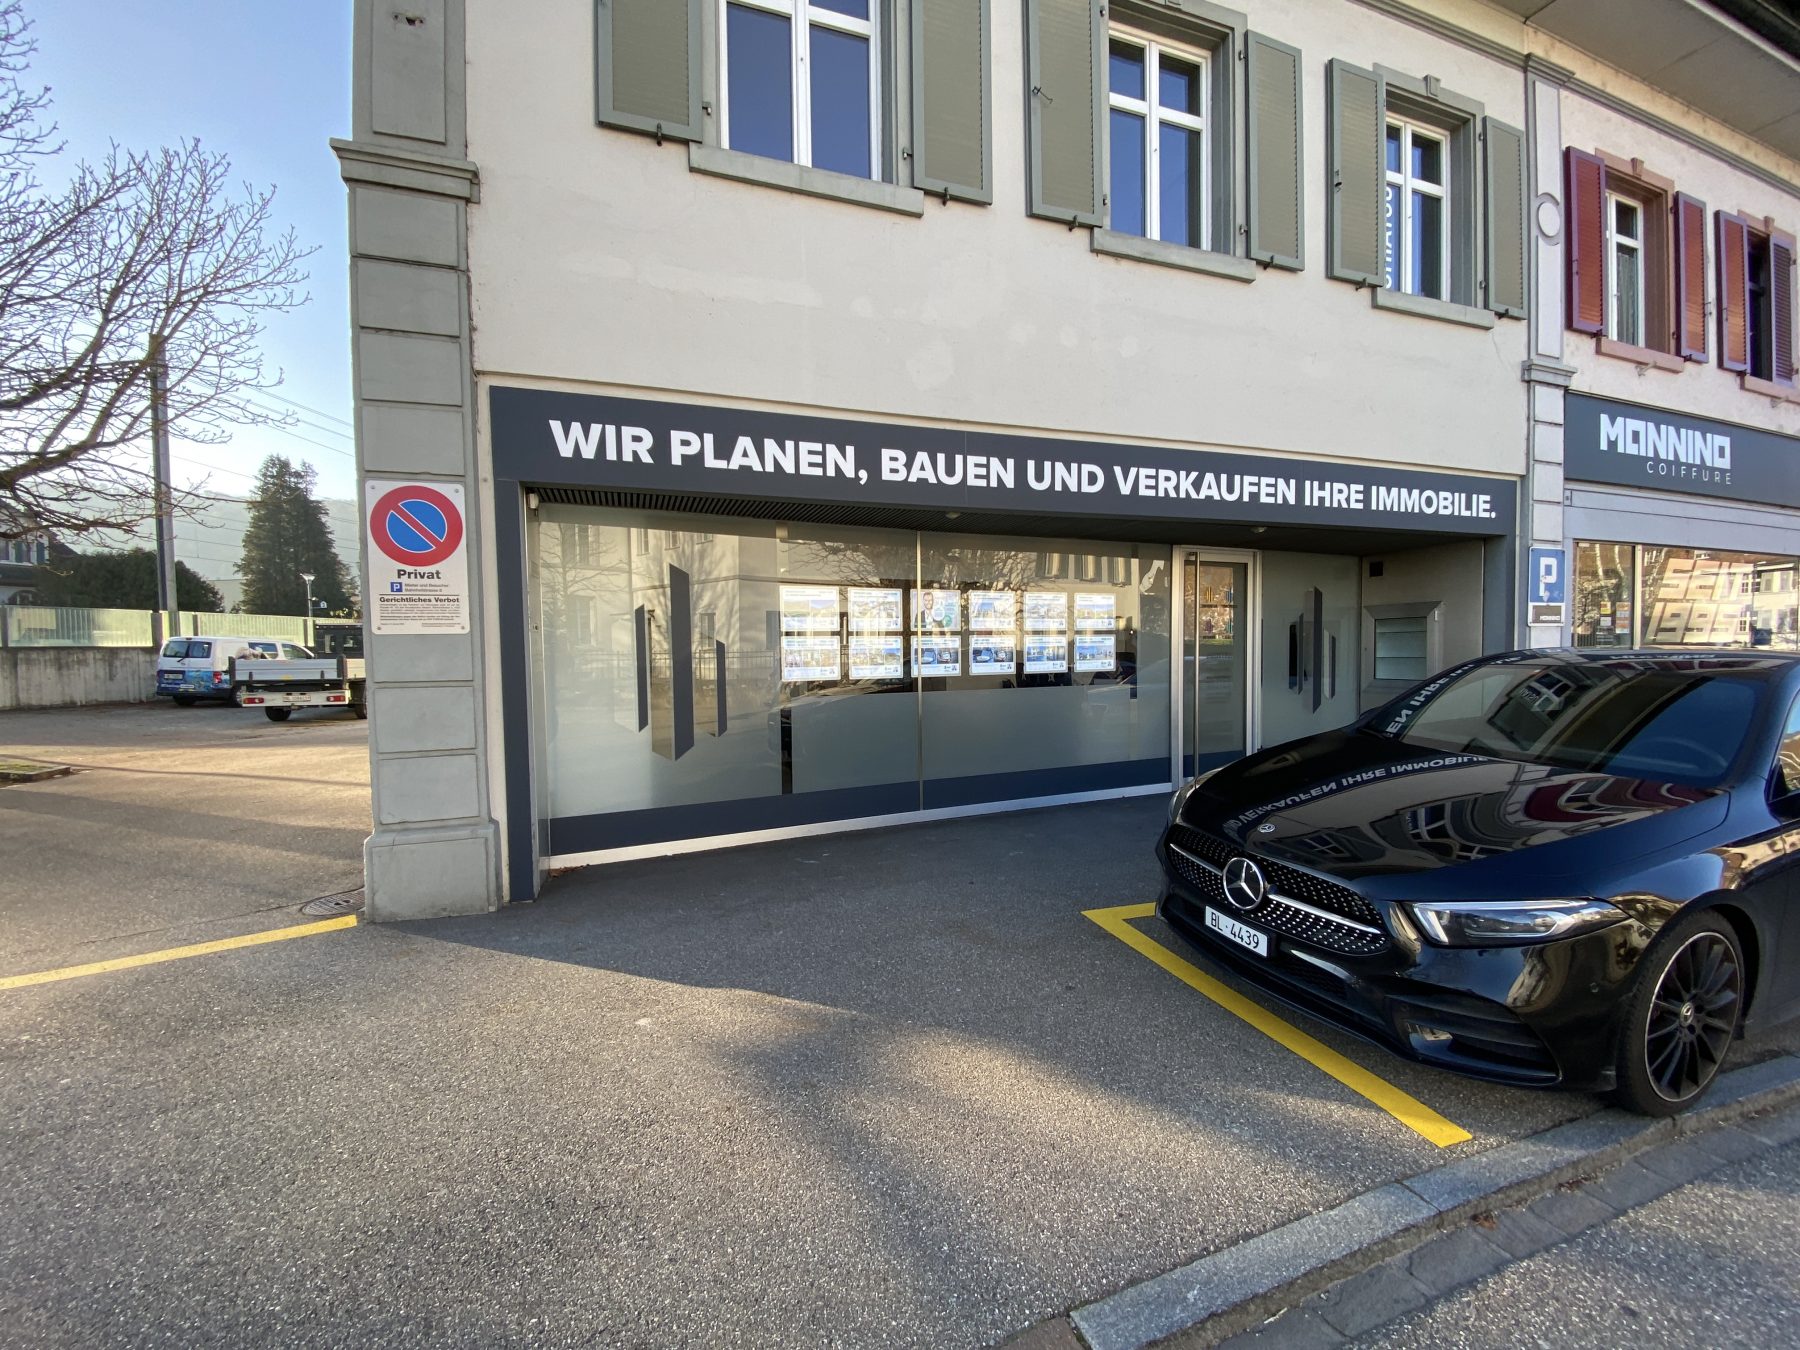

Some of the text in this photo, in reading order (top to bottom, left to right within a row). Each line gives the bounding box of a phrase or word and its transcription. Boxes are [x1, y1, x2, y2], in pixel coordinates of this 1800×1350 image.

[548, 419, 1496, 519] WIR PLANEN, BAUEN UND VERKAUFEN IHRE IMMOBILIE.
[1646, 461, 1733, 485] COIFFURE
[397, 569, 442, 579] Privat
[1539, 556, 1558, 597] P
